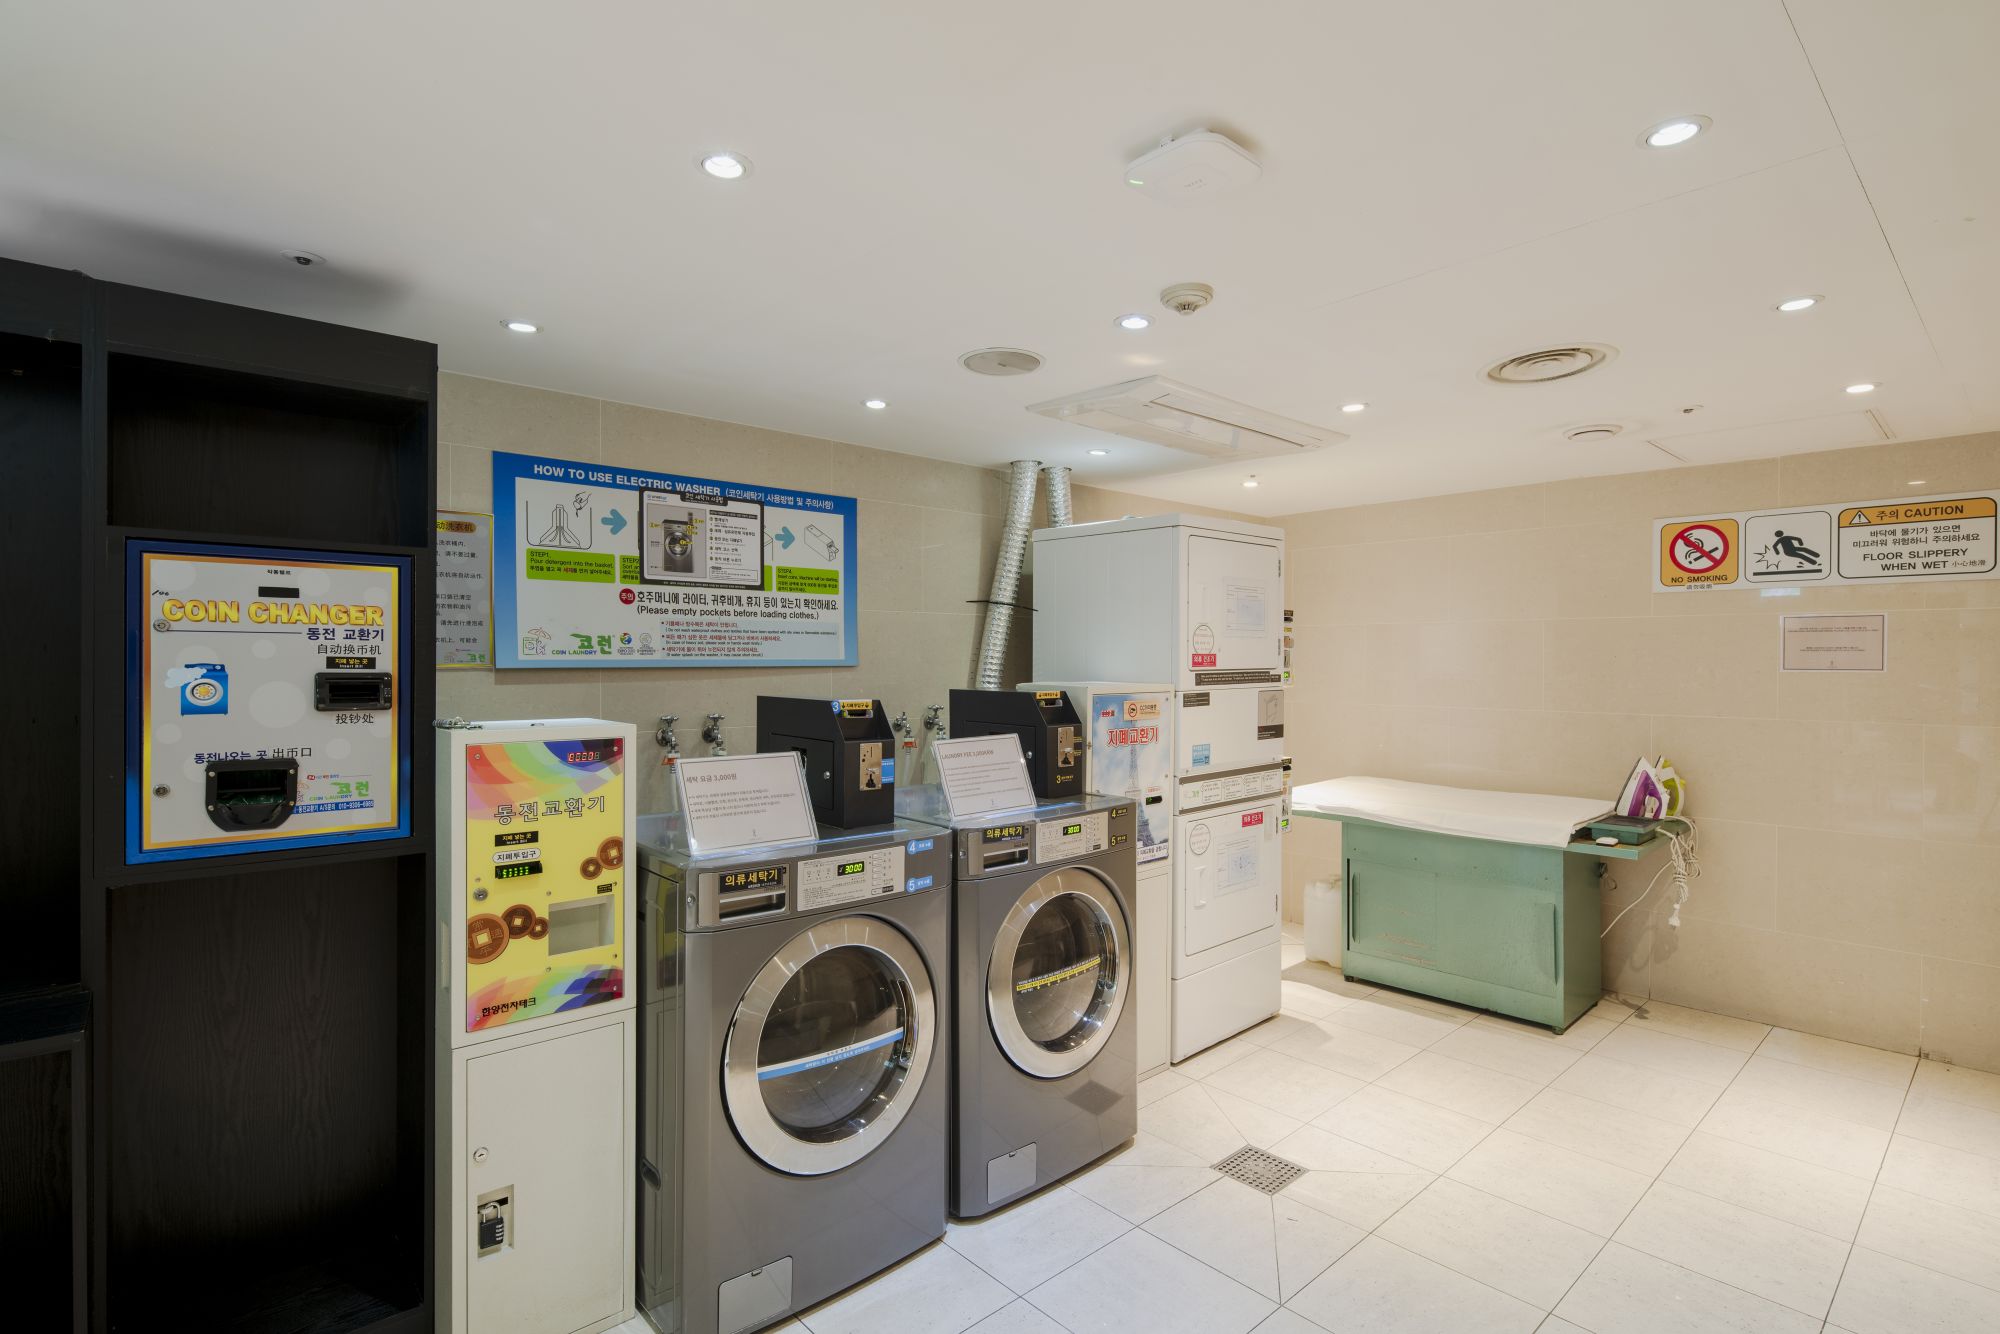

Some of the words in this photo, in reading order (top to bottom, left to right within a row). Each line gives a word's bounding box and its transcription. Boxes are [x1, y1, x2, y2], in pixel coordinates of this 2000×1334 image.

[534, 464, 564, 477] HOW
[568, 468, 585, 480] TO
[588, 471, 613, 483] USE
[616, 474, 672, 490] ELECTRIC
[675, 482, 721, 496] WASHER
[1876, 509, 1899, 521] 주의
[1904, 505, 1964, 518] CAUTION
[1870, 528, 1897, 538] 바닥에
[1901, 526, 1928, 536] 물기가
[1932, 524, 1960, 534] 있으면
[1852, 538, 1888, 548] 미끄러워
[1892, 536, 1928, 546] 위험하니
[1932, 533, 1980, 544] 주의하세요
[1863, 552, 1903, 561] FLOOR
[1908, 548, 1968, 559] SLIPPERY
[1881, 562, 1916, 571] WHEN
[1922, 560, 1948, 570] WET
[1687, 574, 1728, 583] SMOKING
[637, 591, 680, 605] 호주머니에
[746, 595, 761, 608] 휴지
[763, 596, 778, 608] 등이
[780, 597, 801, 609] 있는지
[804, 599, 839, 611] 확인하세요.
[162, 598, 240, 624] COIN
[248, 601, 384, 626] CHANGER
[637, 605, 669, 615] (Please
[672, 607, 697, 616] empty
[700, 607, 731, 617] pockets
[733, 609, 758, 617] before
[760, 610, 787, 619] loading
[789, 611, 819, 620] clothes.)
[306, 627, 336, 641] 동전
[342, 628, 384, 642] 교환기
[317, 643, 382, 655] 自动换币机
[832, 701, 839, 711] 3
[335, 713, 374, 725] 投钞处
[1107, 726, 1159, 746] 지폐교환기
[272, 747, 312, 759] 出币口
[1056, 775, 1062, 784] 3
[494, 795, 605, 826] 동전교환기
[1111, 809, 1117, 818] 4
[986, 826, 1022, 839] 의류세탁기
[909, 841, 916, 852] 4
[1111, 837, 1116, 846] 5
[496, 850, 537, 861] 지폐투입구
[725, 868, 778, 887] 의류세탁기
[909, 880, 915, 891] 5
[482, 997, 537, 1018] 한양전자테크
